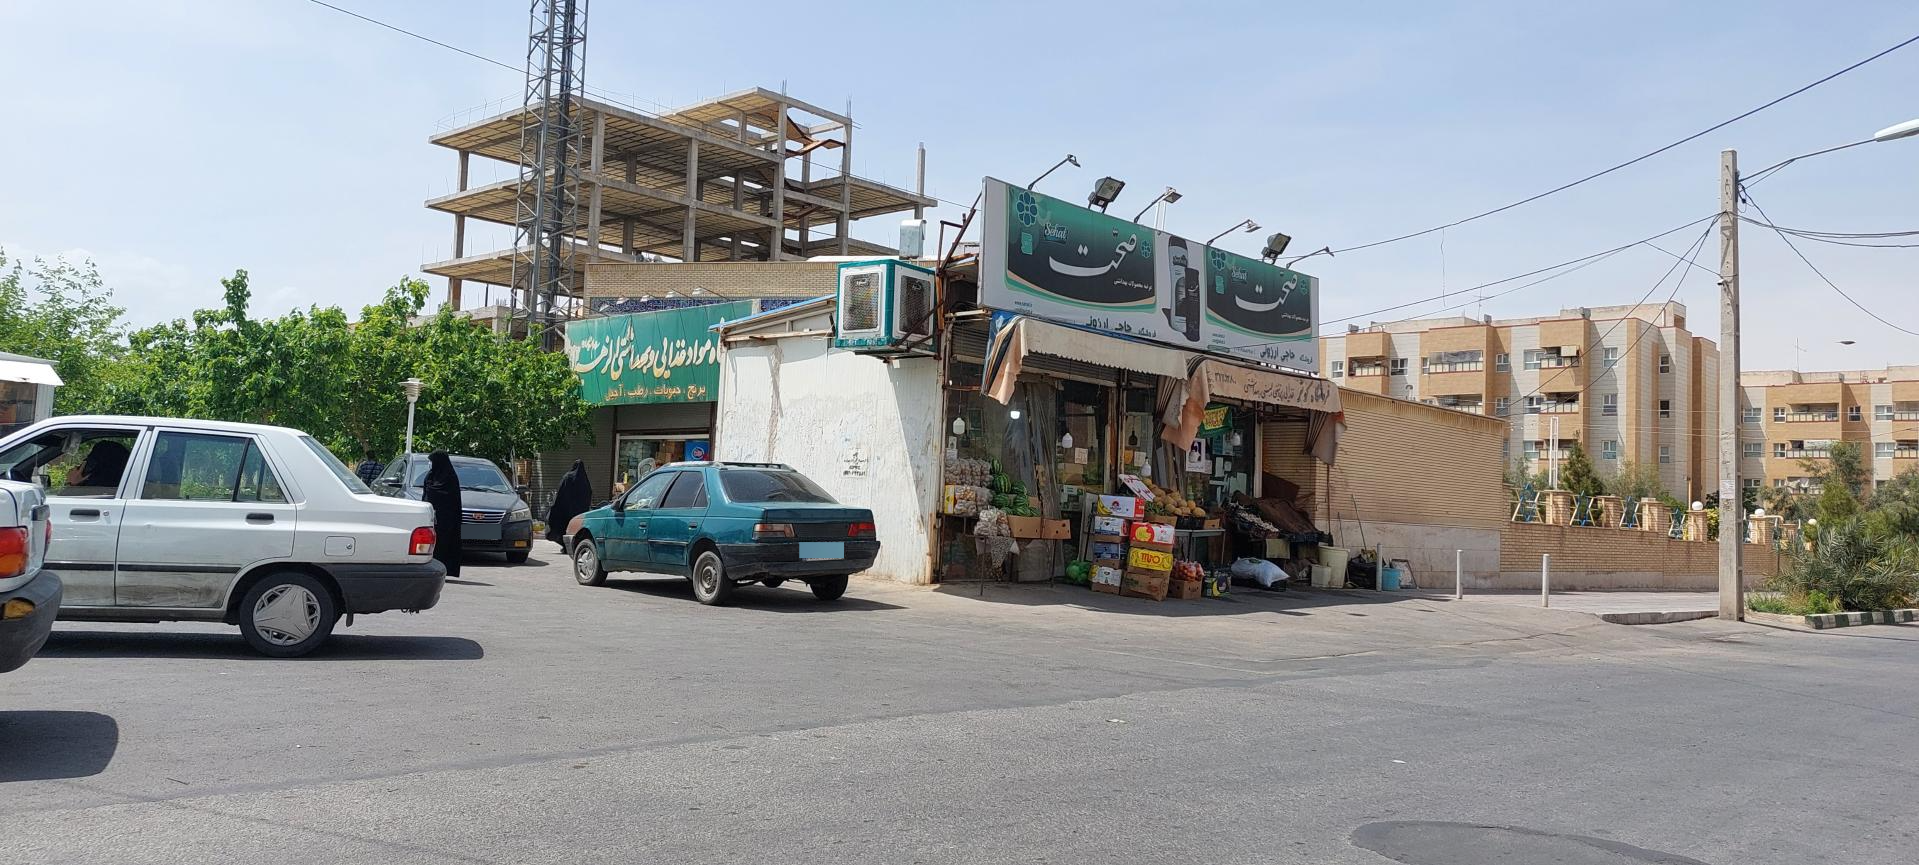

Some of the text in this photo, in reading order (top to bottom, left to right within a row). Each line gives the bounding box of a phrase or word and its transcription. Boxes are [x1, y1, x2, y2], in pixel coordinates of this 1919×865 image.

[1045, 223, 1067, 240] Sehat
[1086, 315, 1109, 329] ارزون
[685, 338, 712, 367] مواد
[654, 383, 682, 399] حبوبات
[687, 384, 706, 400] برنج
